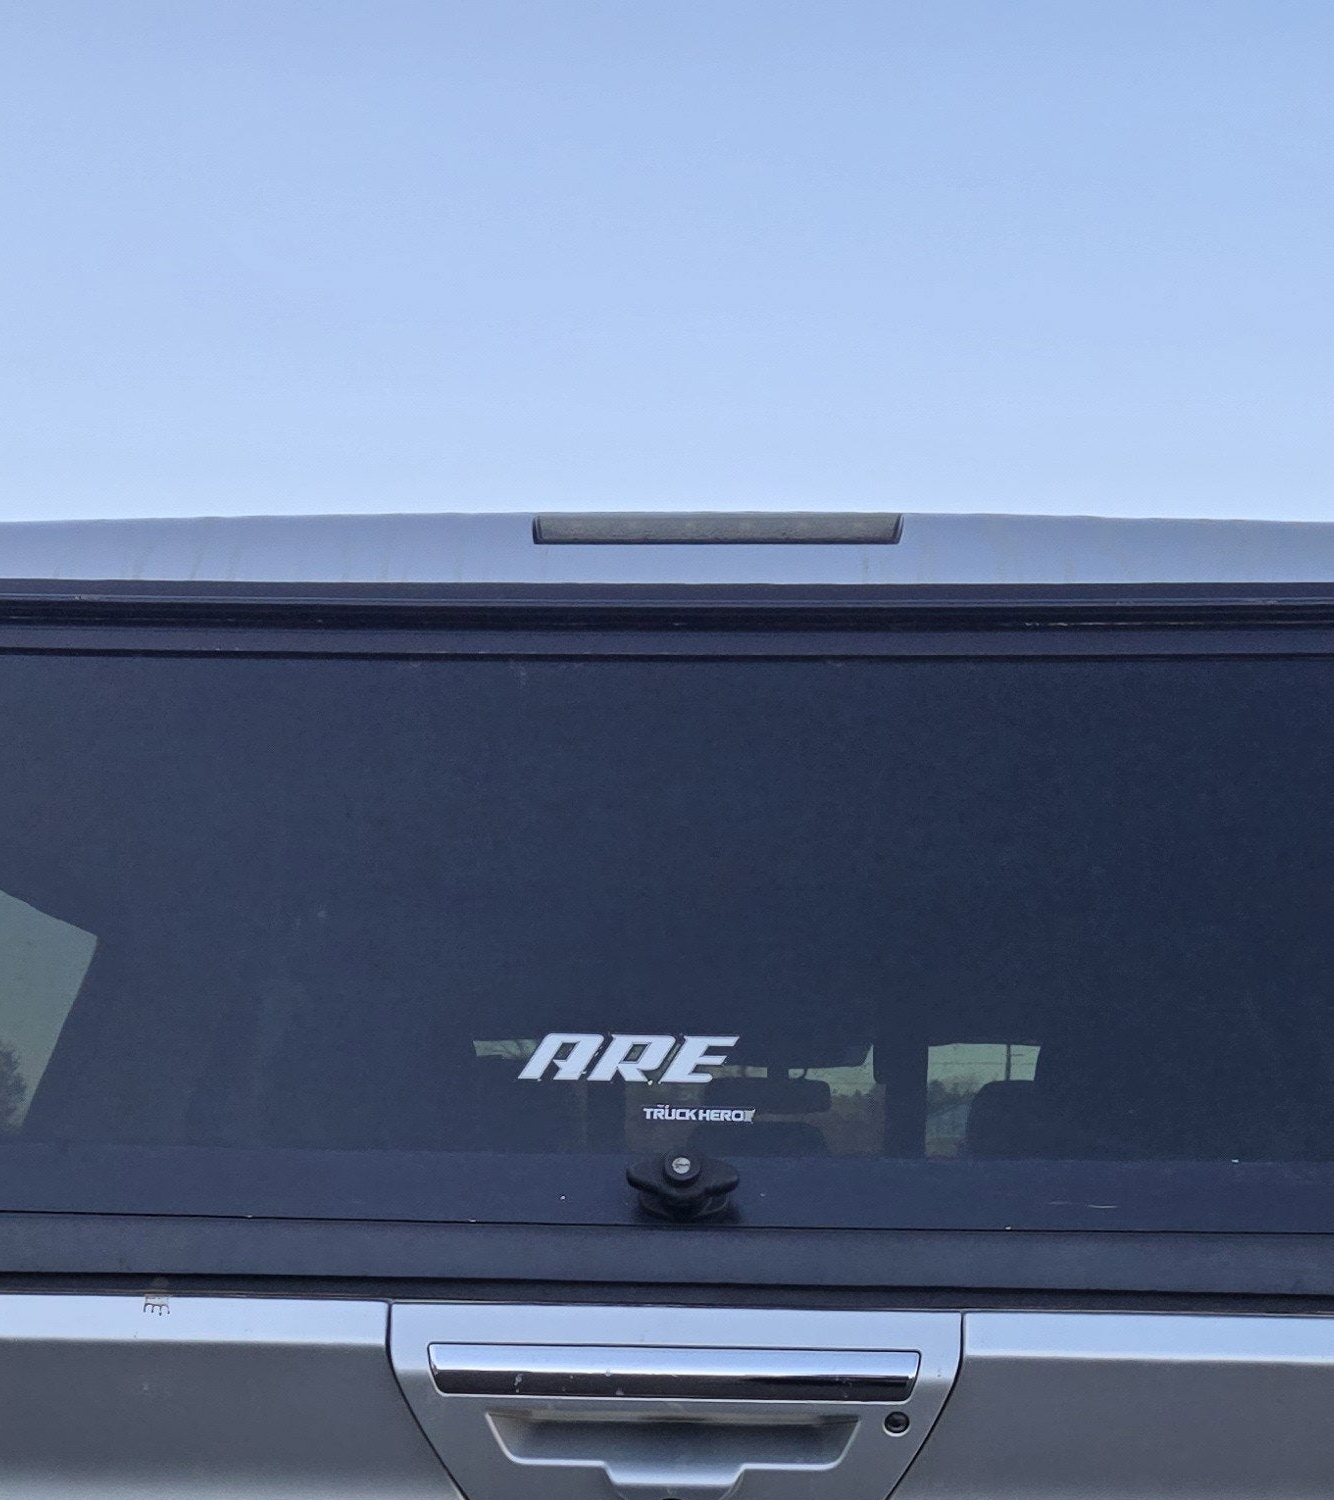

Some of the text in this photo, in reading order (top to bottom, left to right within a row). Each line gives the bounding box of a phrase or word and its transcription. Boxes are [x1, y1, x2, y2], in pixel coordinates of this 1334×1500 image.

[518, 1032, 740, 1084] ARE
[643, 1106, 744, 1122] TRUCK HERO
